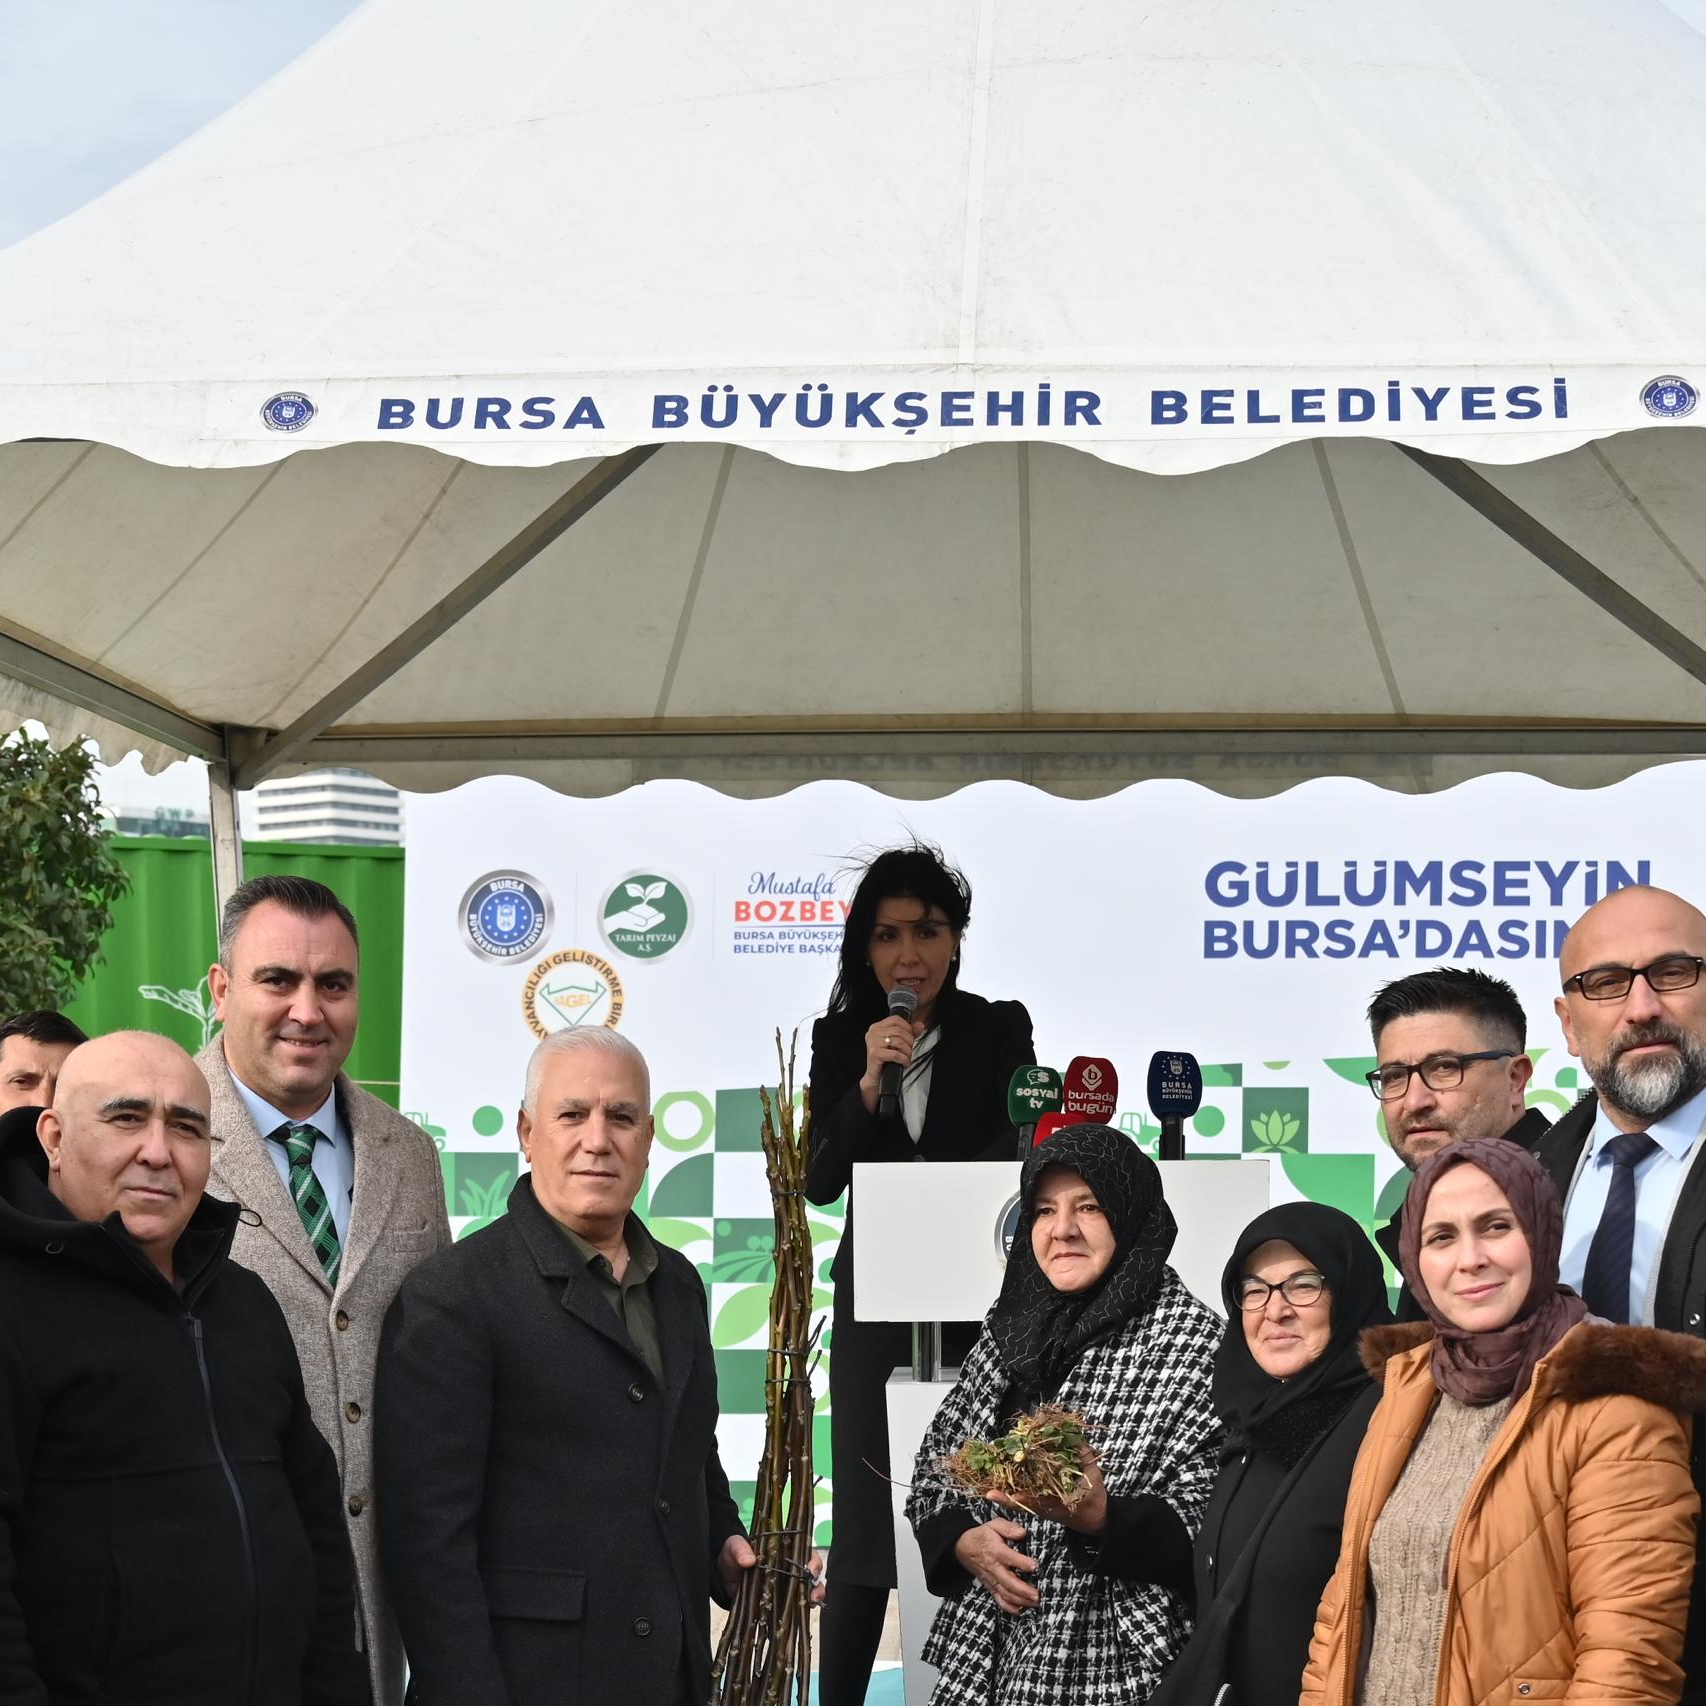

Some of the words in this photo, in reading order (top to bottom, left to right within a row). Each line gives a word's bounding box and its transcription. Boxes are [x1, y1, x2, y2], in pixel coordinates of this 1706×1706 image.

[377, 396, 606, 431] BURSA
[651, 383, 1102, 435] BÜYÜKŞEHİR
[1150, 377, 1569, 426] BELEDİYESİ
[489, 880, 525, 893] BURSA
[748, 871, 837, 902] Mustafa
[1204, 860, 1651, 907] GÜLÜMSEYİN
[615, 934, 644, 942] TARIM
[646, 934, 676, 943] PEYZAJ
[734, 931, 775, 941] BURSA
[779, 929, 845, 942] BÜYÜKŞEH
[733, 942, 795, 954] BELEDİYE
[799, 943, 842, 956] BAŞKA
[1161, 1081, 1193, 1089] BURSA
[1016, 1088, 1059, 1099] sosyal
[1068, 1090, 1115, 1103] bursada
[1029, 1098, 1044, 1109] tv
[1068, 1100, 1114, 1114] bugün
